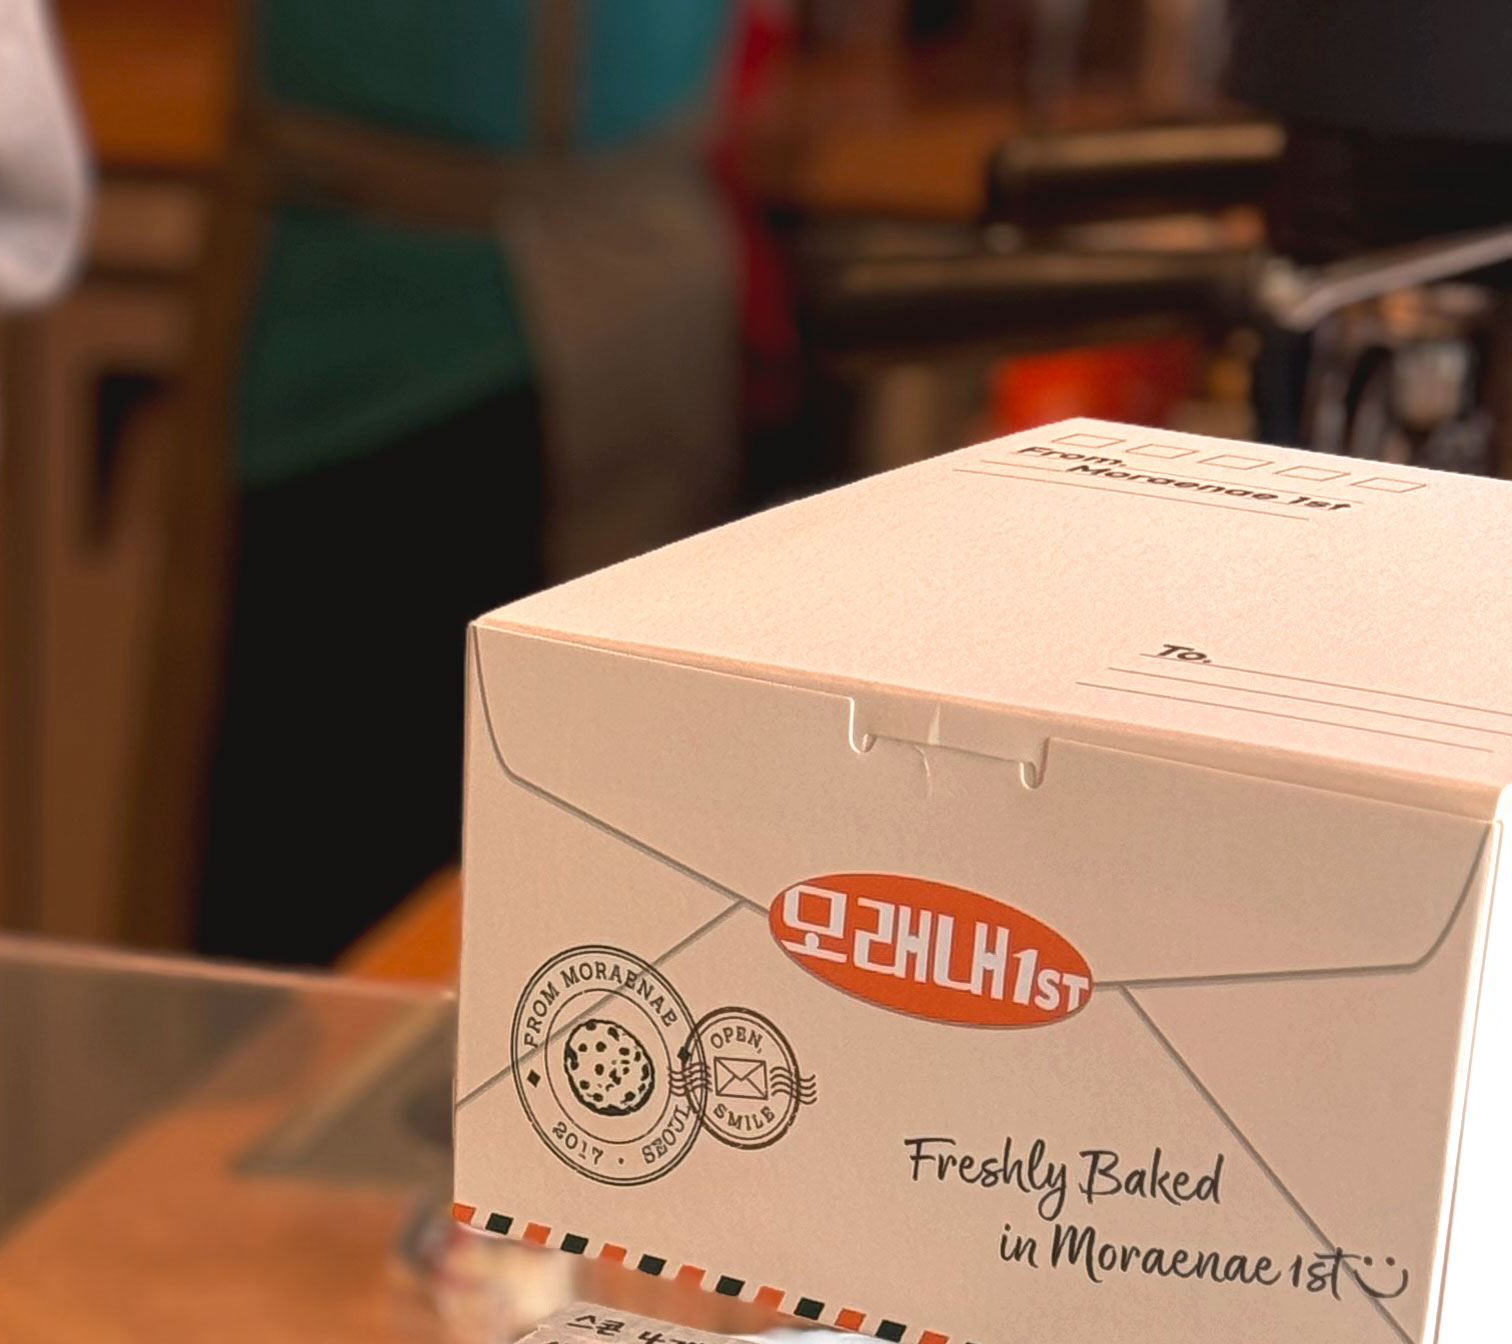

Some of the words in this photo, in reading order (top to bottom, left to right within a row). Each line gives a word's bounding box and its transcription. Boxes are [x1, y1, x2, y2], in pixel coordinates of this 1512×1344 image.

[1066, 464, 1279, 501] Moraenae
[1288, 495, 1352, 512] 1st
[1157, 643, 1212, 664] To.
[523, 980, 560, 1050] FROM
[560, 960, 679, 1028] MORAENAE
[551, 1120, 604, 1166] 2017
[640, 1104, 692, 1165] SEOUL
[712, 1102, 776, 1131] SMILE
[904, 1136, 1068, 1222] Freshly
[1079, 1147, 1225, 1206] Baked
[999, 1222, 1039, 1269] in
[1051, 1223, 1282, 1286] Moraenae
[1290, 1246, 1362, 1300] 1st
[566, 1314, 627, 1337] 스콘
